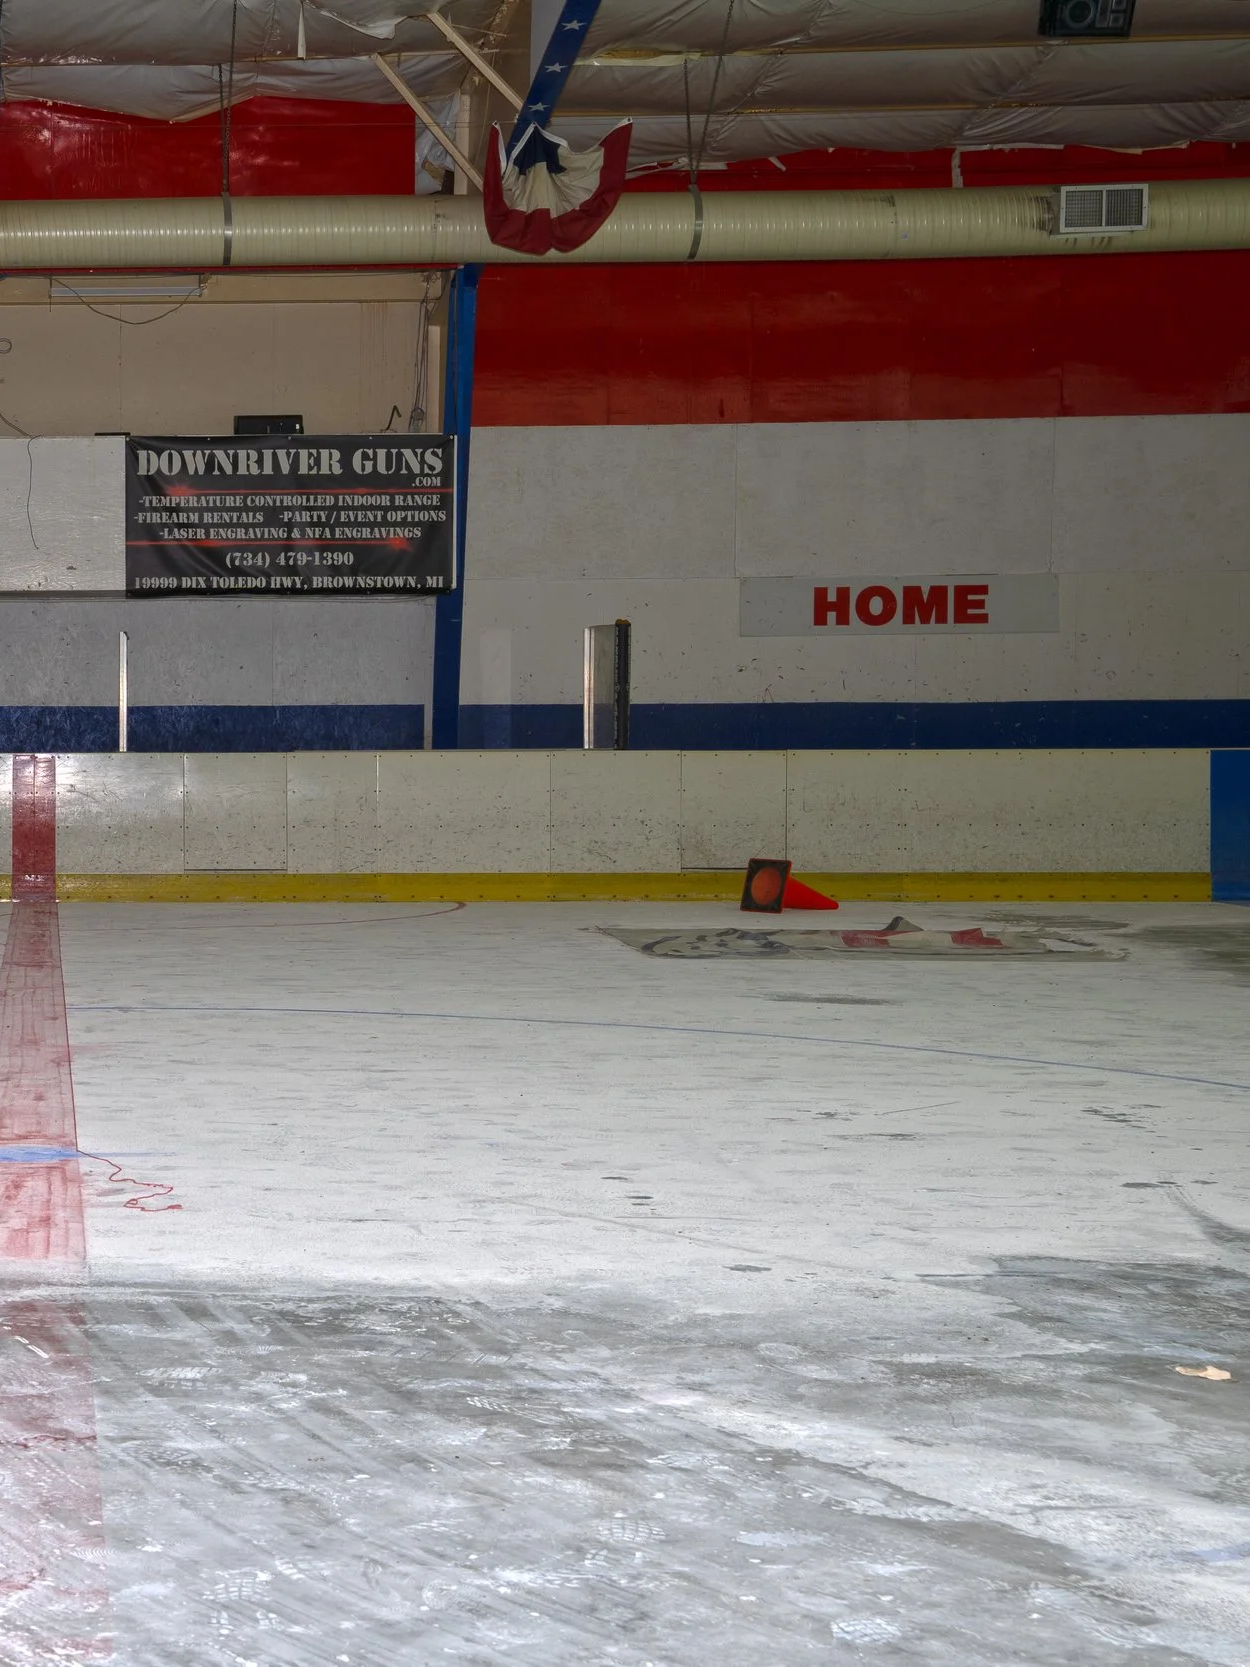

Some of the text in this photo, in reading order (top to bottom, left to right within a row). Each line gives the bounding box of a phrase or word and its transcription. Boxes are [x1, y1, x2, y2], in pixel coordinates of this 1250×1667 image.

[137, 448, 443, 476] DOWNRIVER GUNS
[412, 477, 441, 487] .COM
[139, 494, 441, 508] -TEMPERATURE CONTROLLED INDOOR RANGE
[133, 512, 199, 524] -FIREARM
[203, 512, 264, 524] RENTALS
[279, 511, 328, 523] -PARTY
[340, 511, 384, 522] EVENT
[386, 510, 447, 522] OPTIONS
[159, 527, 422, 540] -LASER ENGRAVING & NFA ENGRAVINGS
[225, 551, 354, 569] (734) 479-1390
[134, 576, 444, 590] 19999 DIX TOLEDO HWY, BROWNSTOWN, MI
[813, 585, 990, 626] HOME
